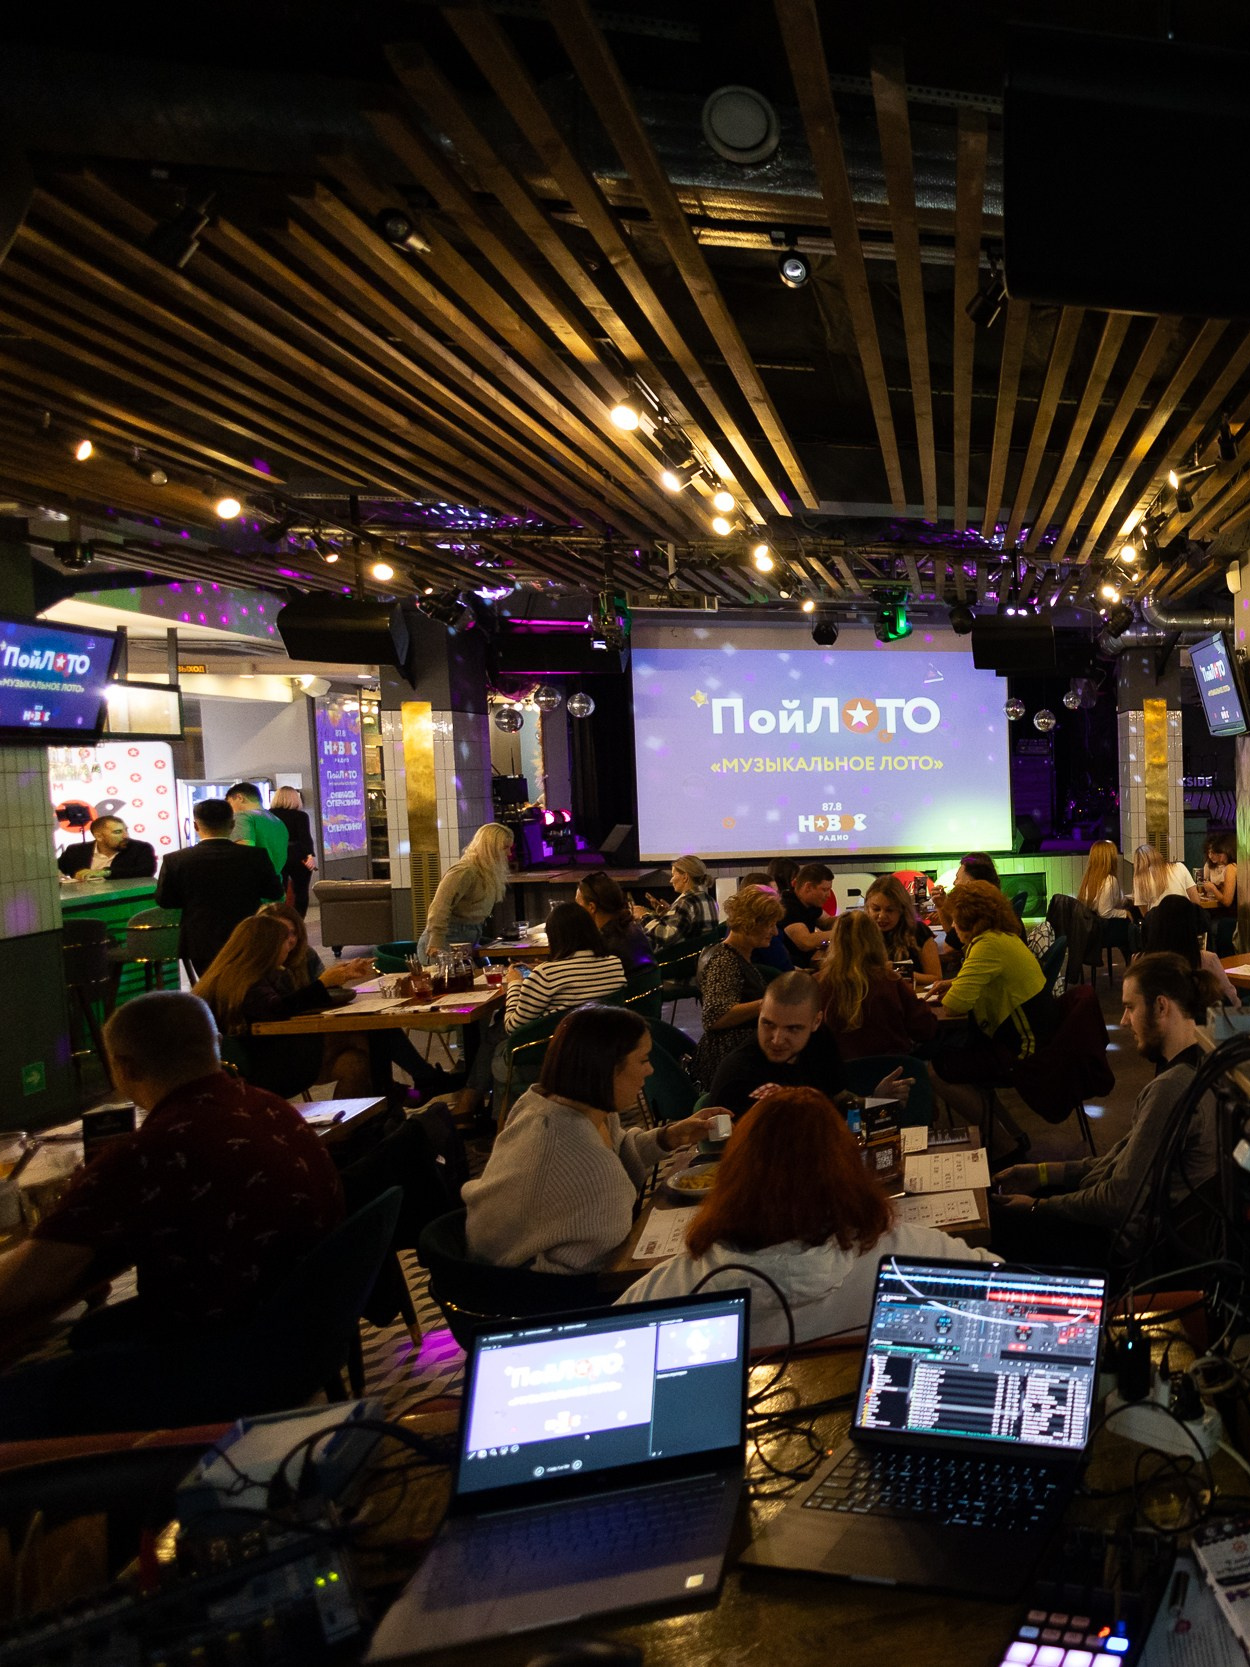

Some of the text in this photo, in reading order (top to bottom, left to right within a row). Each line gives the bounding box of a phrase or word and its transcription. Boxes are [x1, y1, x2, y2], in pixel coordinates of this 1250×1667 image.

[4, 645, 91, 675] ПойЛОТО
[710, 696, 941, 735] ПойЛОТО
[710, 754, 944, 774] «МУЗЫКАЛЬНОЕ ЛОТО»
[821, 801, 843, 812] 87.8
[817, 833, 849, 842] РАДИО
